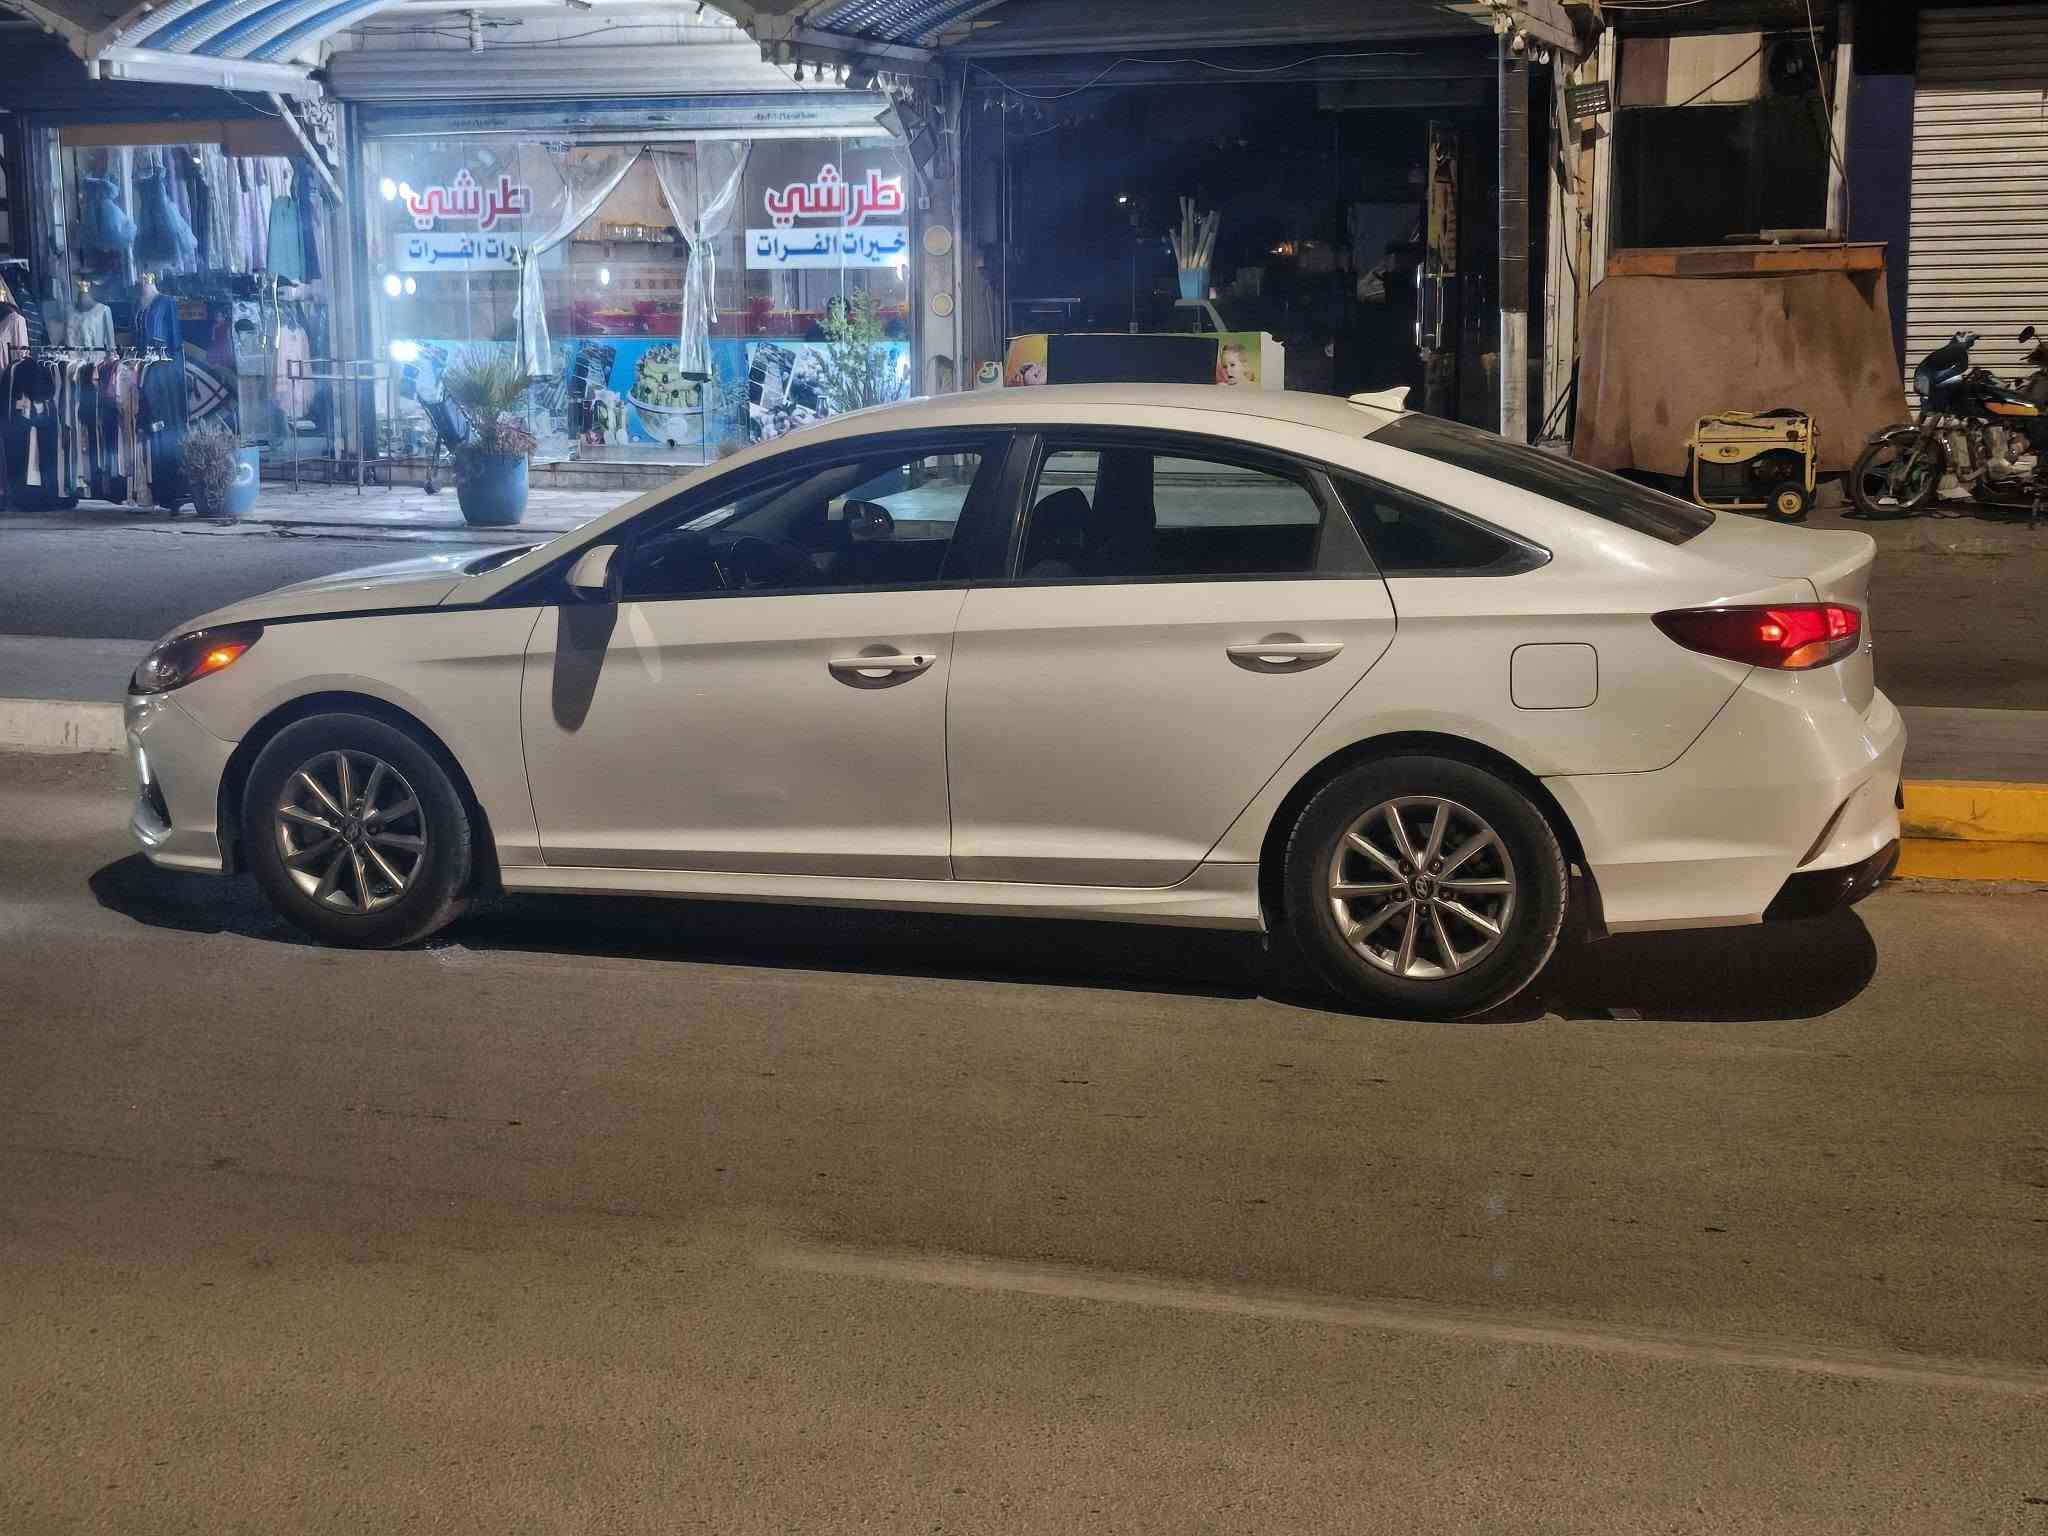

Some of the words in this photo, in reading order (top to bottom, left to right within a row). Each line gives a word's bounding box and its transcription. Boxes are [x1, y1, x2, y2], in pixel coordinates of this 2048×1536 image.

[409, 171, 532, 229] طرشي
[767, 167, 903, 227] طرشي
[408, 238, 481, 265] الفرات
[756, 233, 838, 262] الفرات
[842, 232, 906, 262] خيرات
